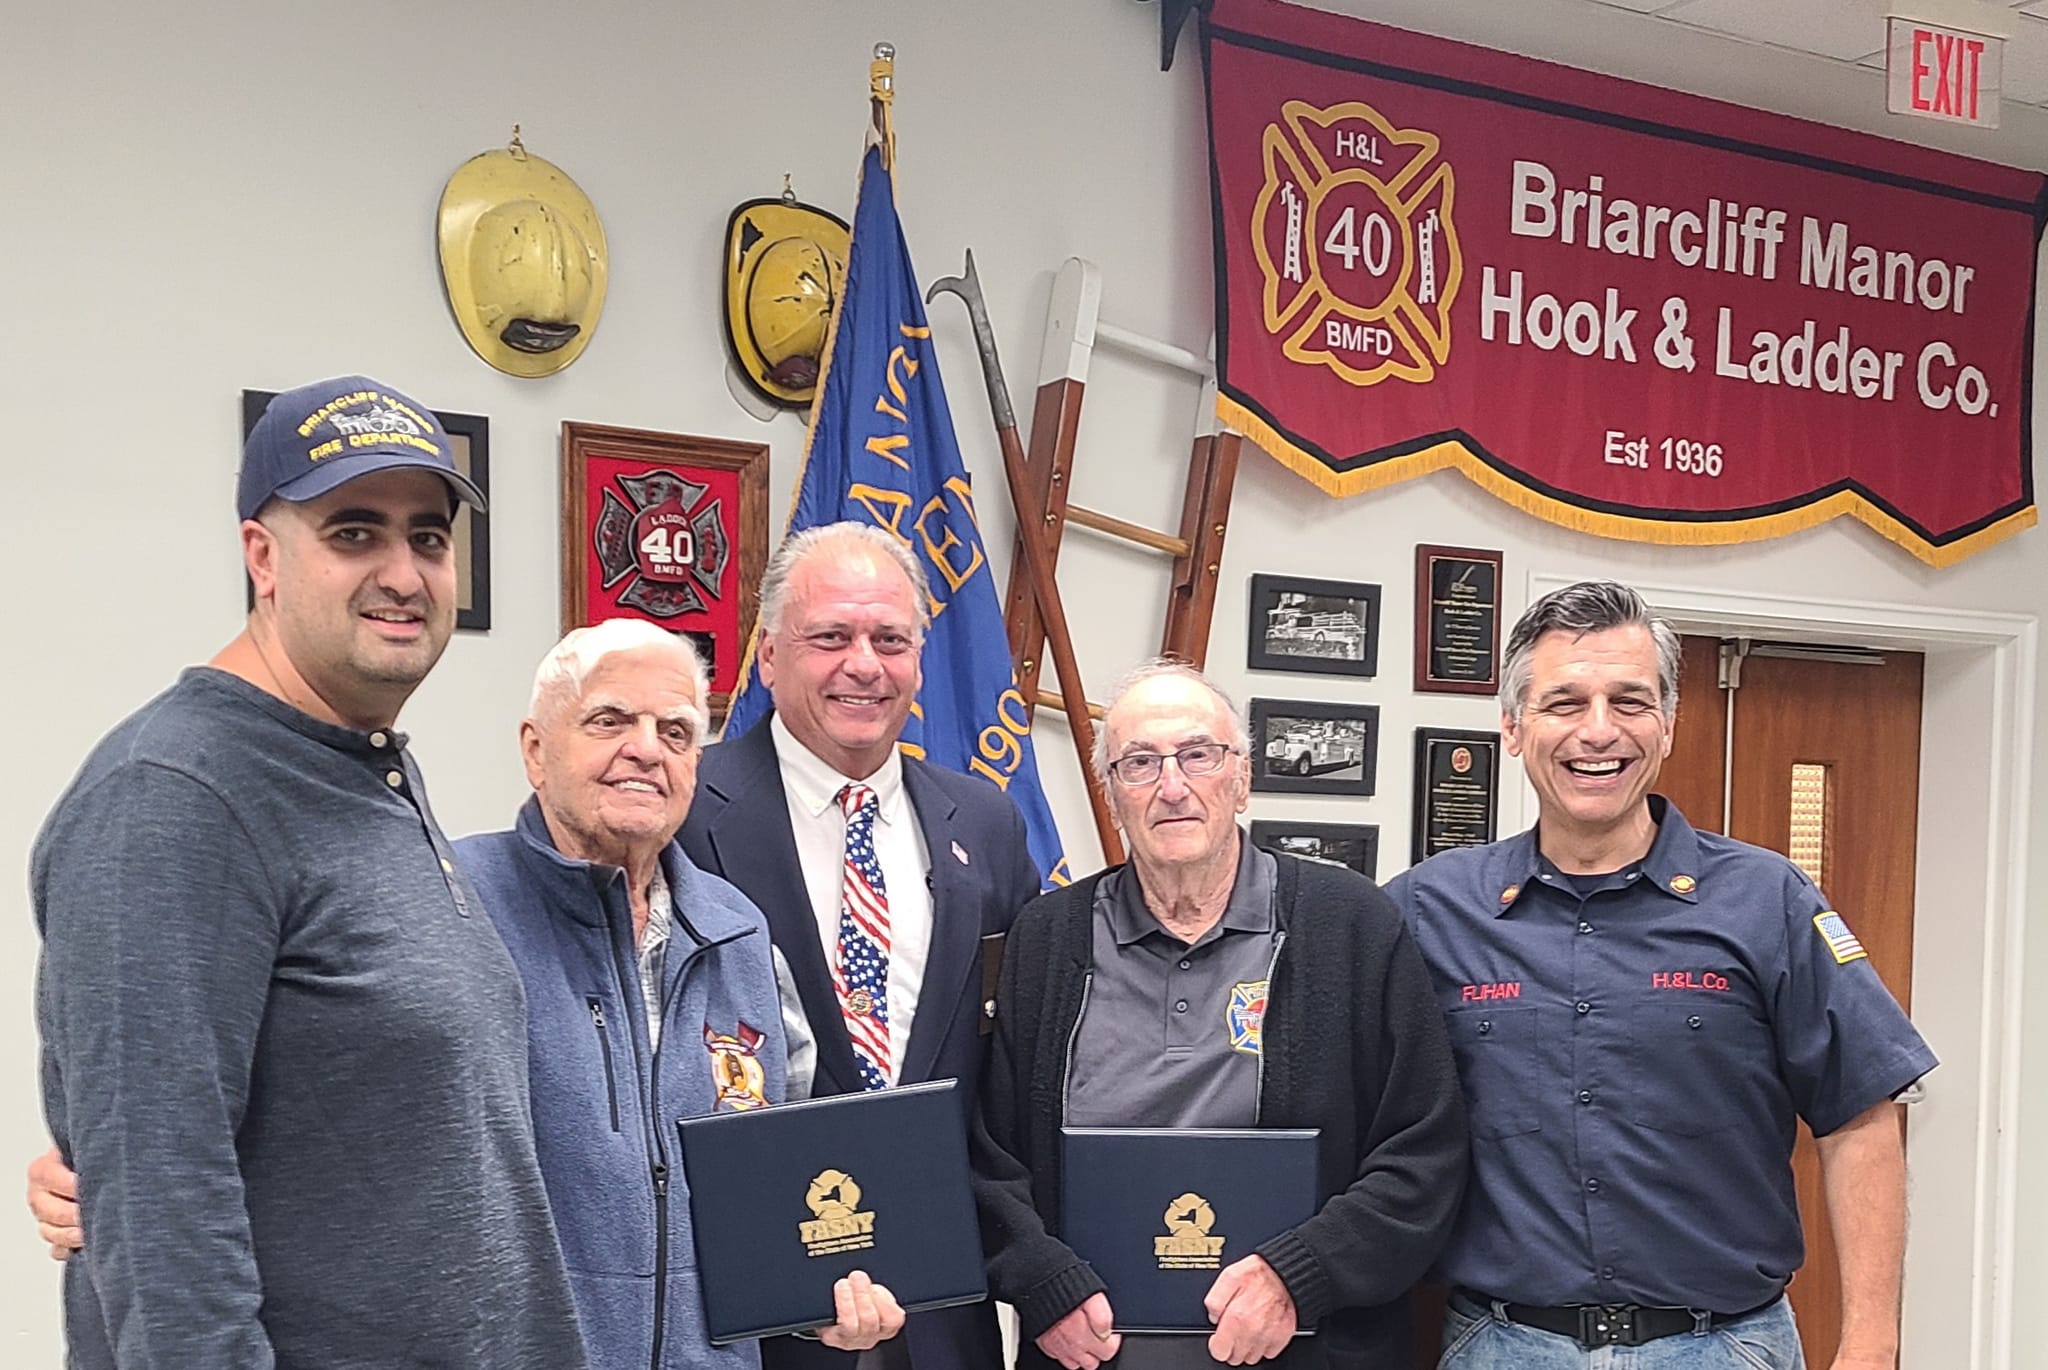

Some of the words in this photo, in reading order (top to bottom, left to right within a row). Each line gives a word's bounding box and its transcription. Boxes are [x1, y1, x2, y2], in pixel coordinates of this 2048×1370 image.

[1912, 29, 1985, 119] EXIT
[1335, 130, 1384, 165] H&L
[1324, 207, 1392, 276] 40
[1511, 160, 1788, 280] Briarcliff
[1800, 216, 1974, 314] Manor
[1326, 320, 1393, 356] BMFD
[1480, 266, 1638, 363] Hook
[1653, 297, 1697, 374] &
[1716, 307, 1903, 401] Ladder
[1917, 342, 1999, 418] Co.
[309, 439, 344, 461] FIRE
[1604, 430, 1650, 470] Est
[1660, 437, 1723, 477] 1936
[641, 527, 694, 564] 40
